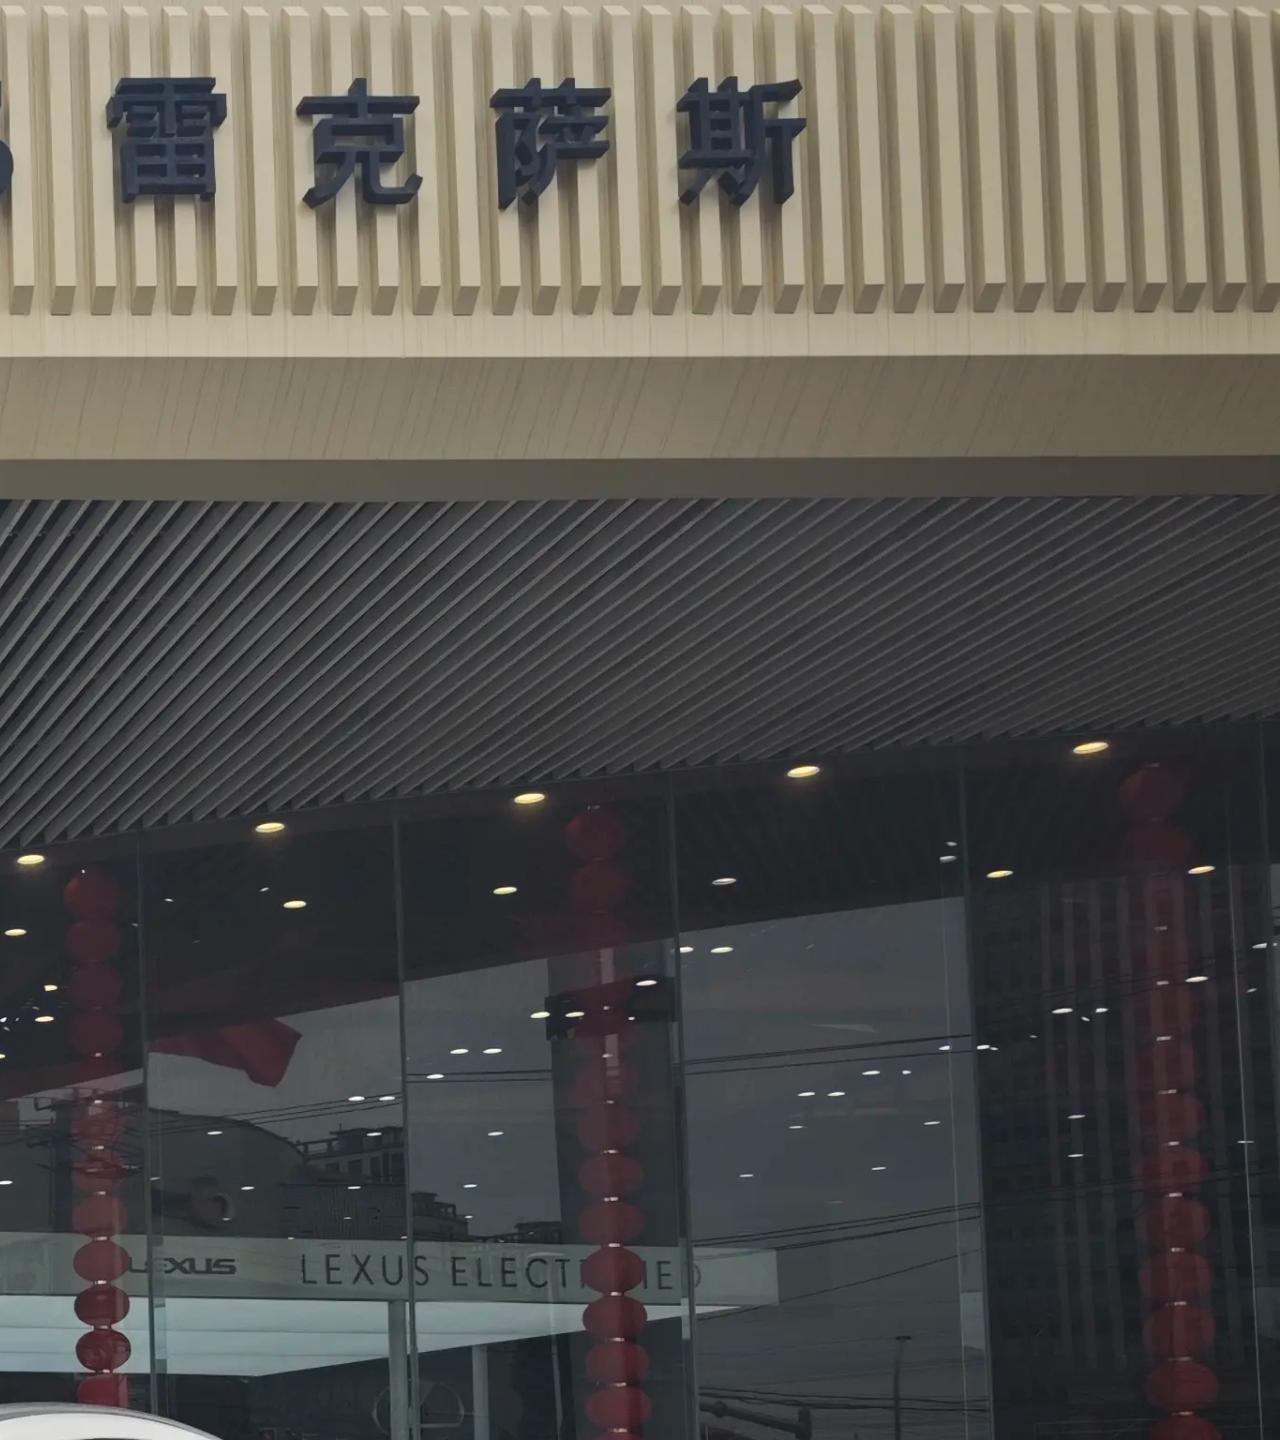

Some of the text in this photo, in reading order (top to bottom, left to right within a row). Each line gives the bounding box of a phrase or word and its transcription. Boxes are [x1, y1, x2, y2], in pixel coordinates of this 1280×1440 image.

[105, 75, 807, 211] 雷克萨斯
[301, 1253, 701, 1291] LEXUS ELECTIE
